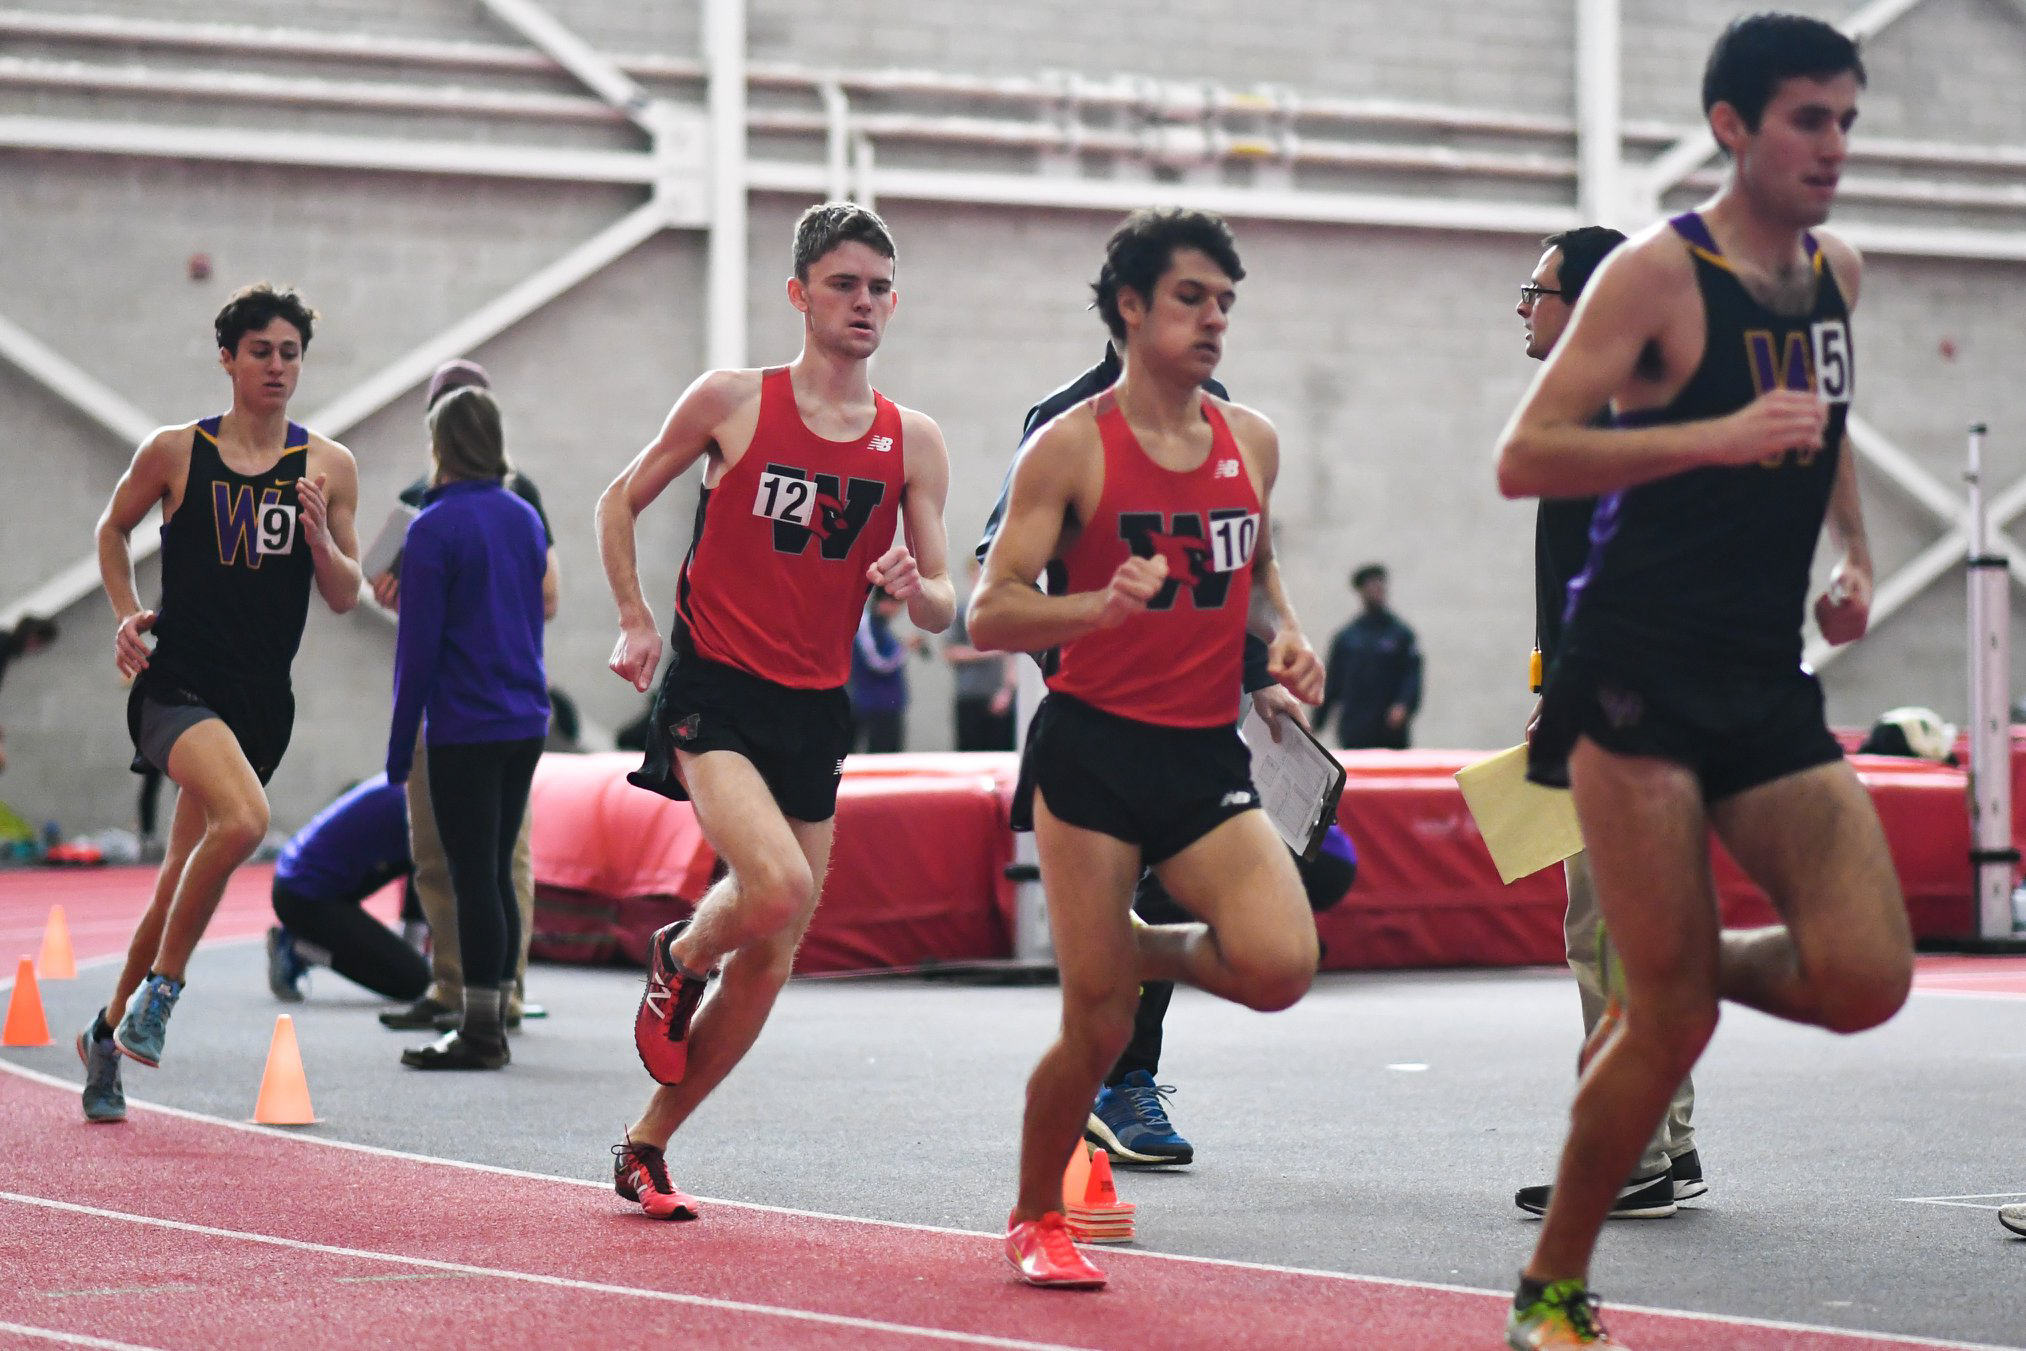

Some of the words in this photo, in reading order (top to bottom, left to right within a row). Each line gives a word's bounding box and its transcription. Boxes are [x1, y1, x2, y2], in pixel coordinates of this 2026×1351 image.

[1822, 329, 1845, 397] 5
[764, 477, 808, 523] 12
[211, 480, 282, 570] W
[263, 508, 290, 550] 9
[1217, 518, 1254, 567] 10
